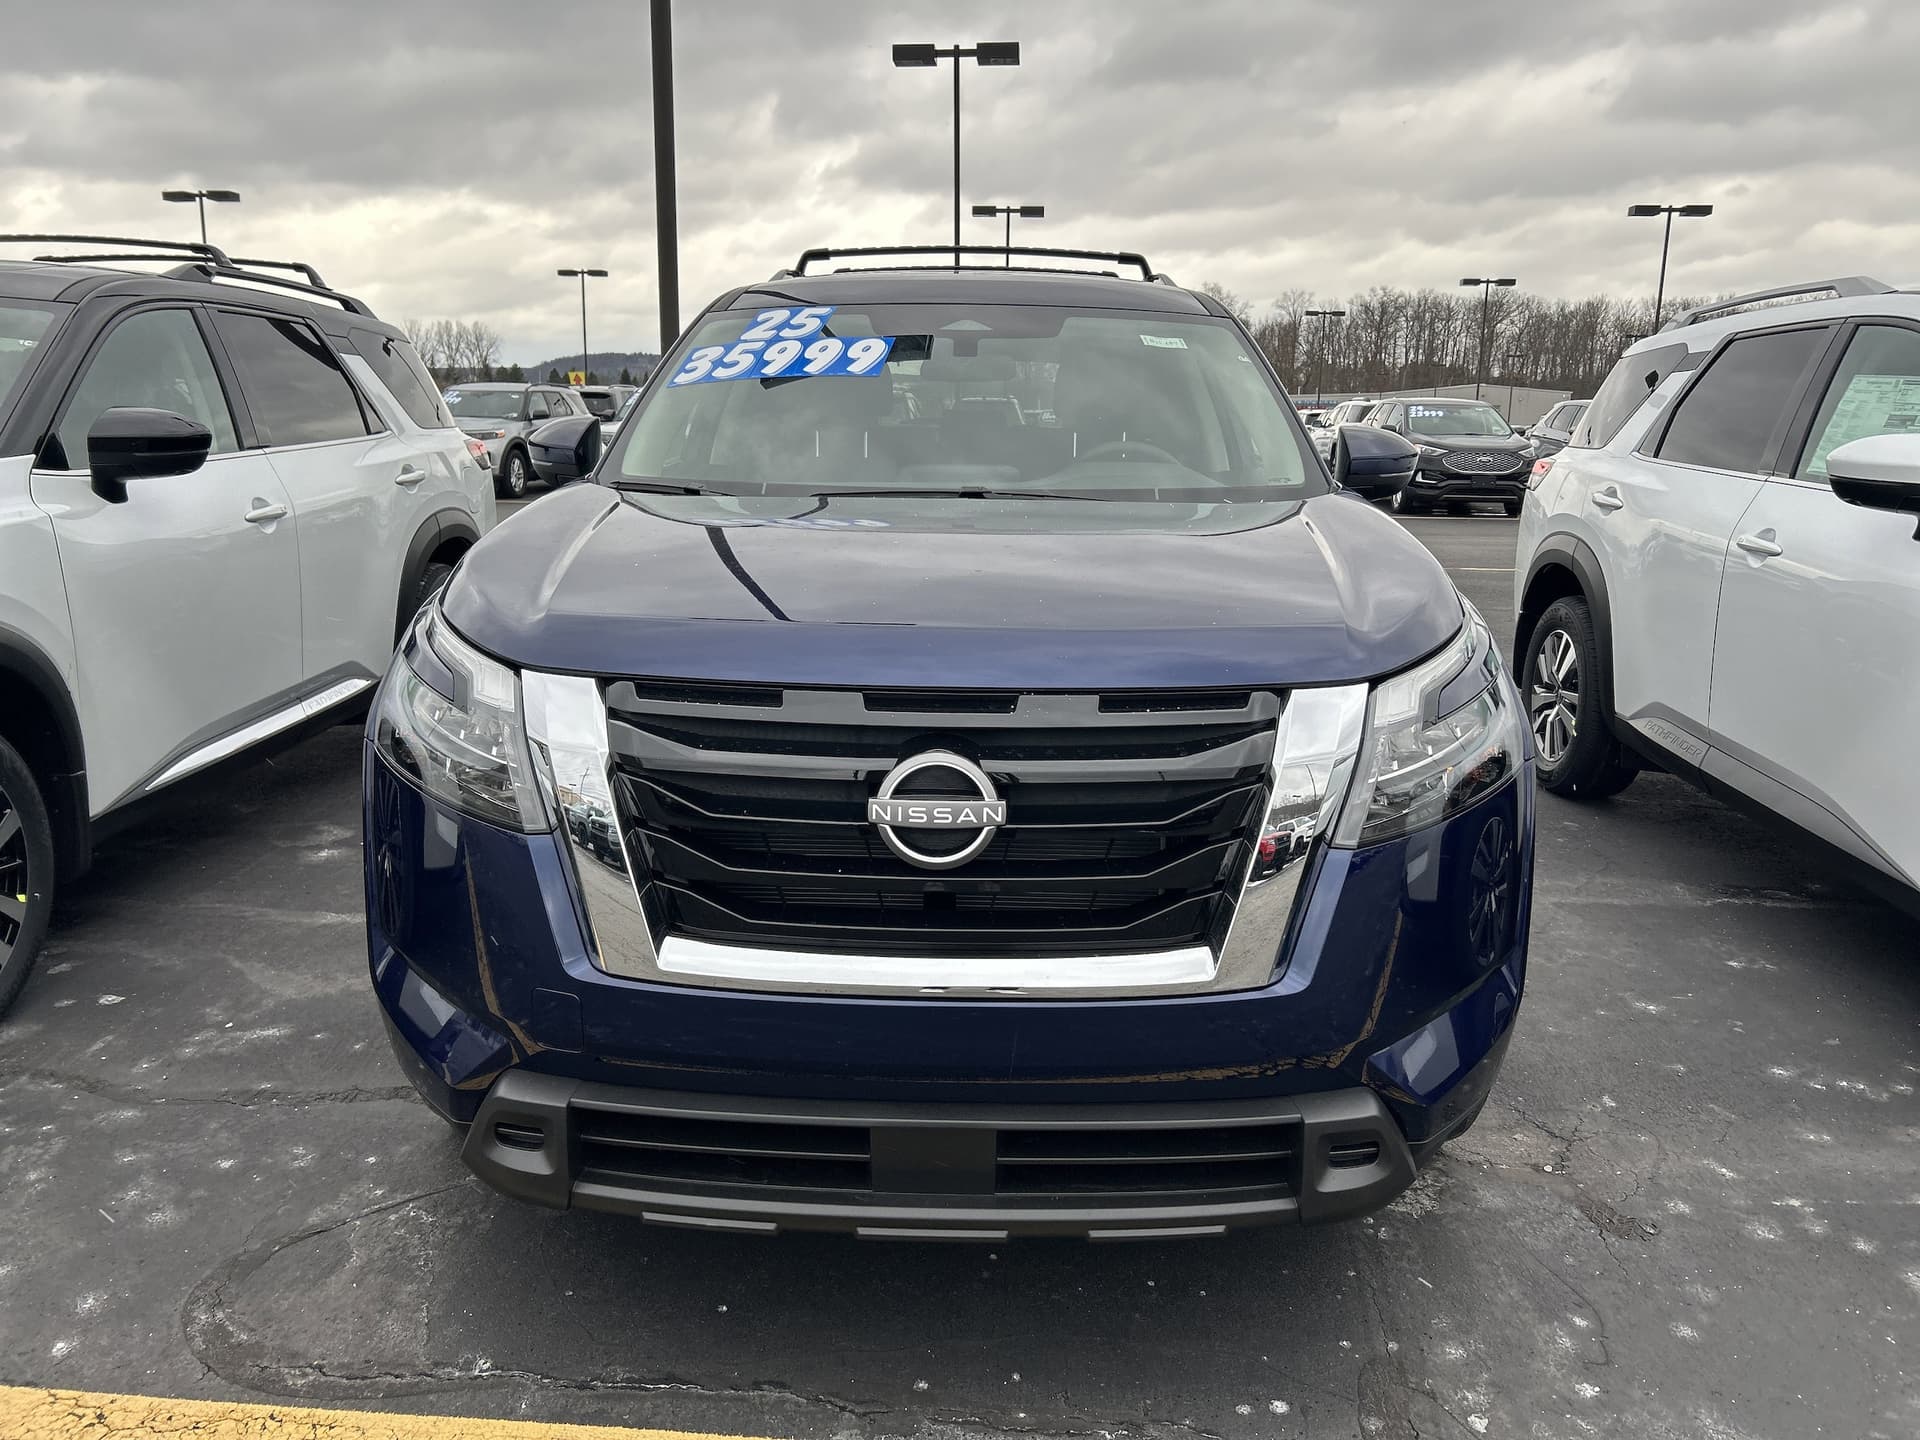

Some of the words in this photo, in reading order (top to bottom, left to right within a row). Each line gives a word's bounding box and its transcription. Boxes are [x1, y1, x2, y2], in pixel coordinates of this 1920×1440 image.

[740, 307, 833, 342] 25
[673, 338, 889, 385] 35999
[1643, 719, 1704, 757] PATHFINDER
[872, 804, 1002, 823] NISSAN
